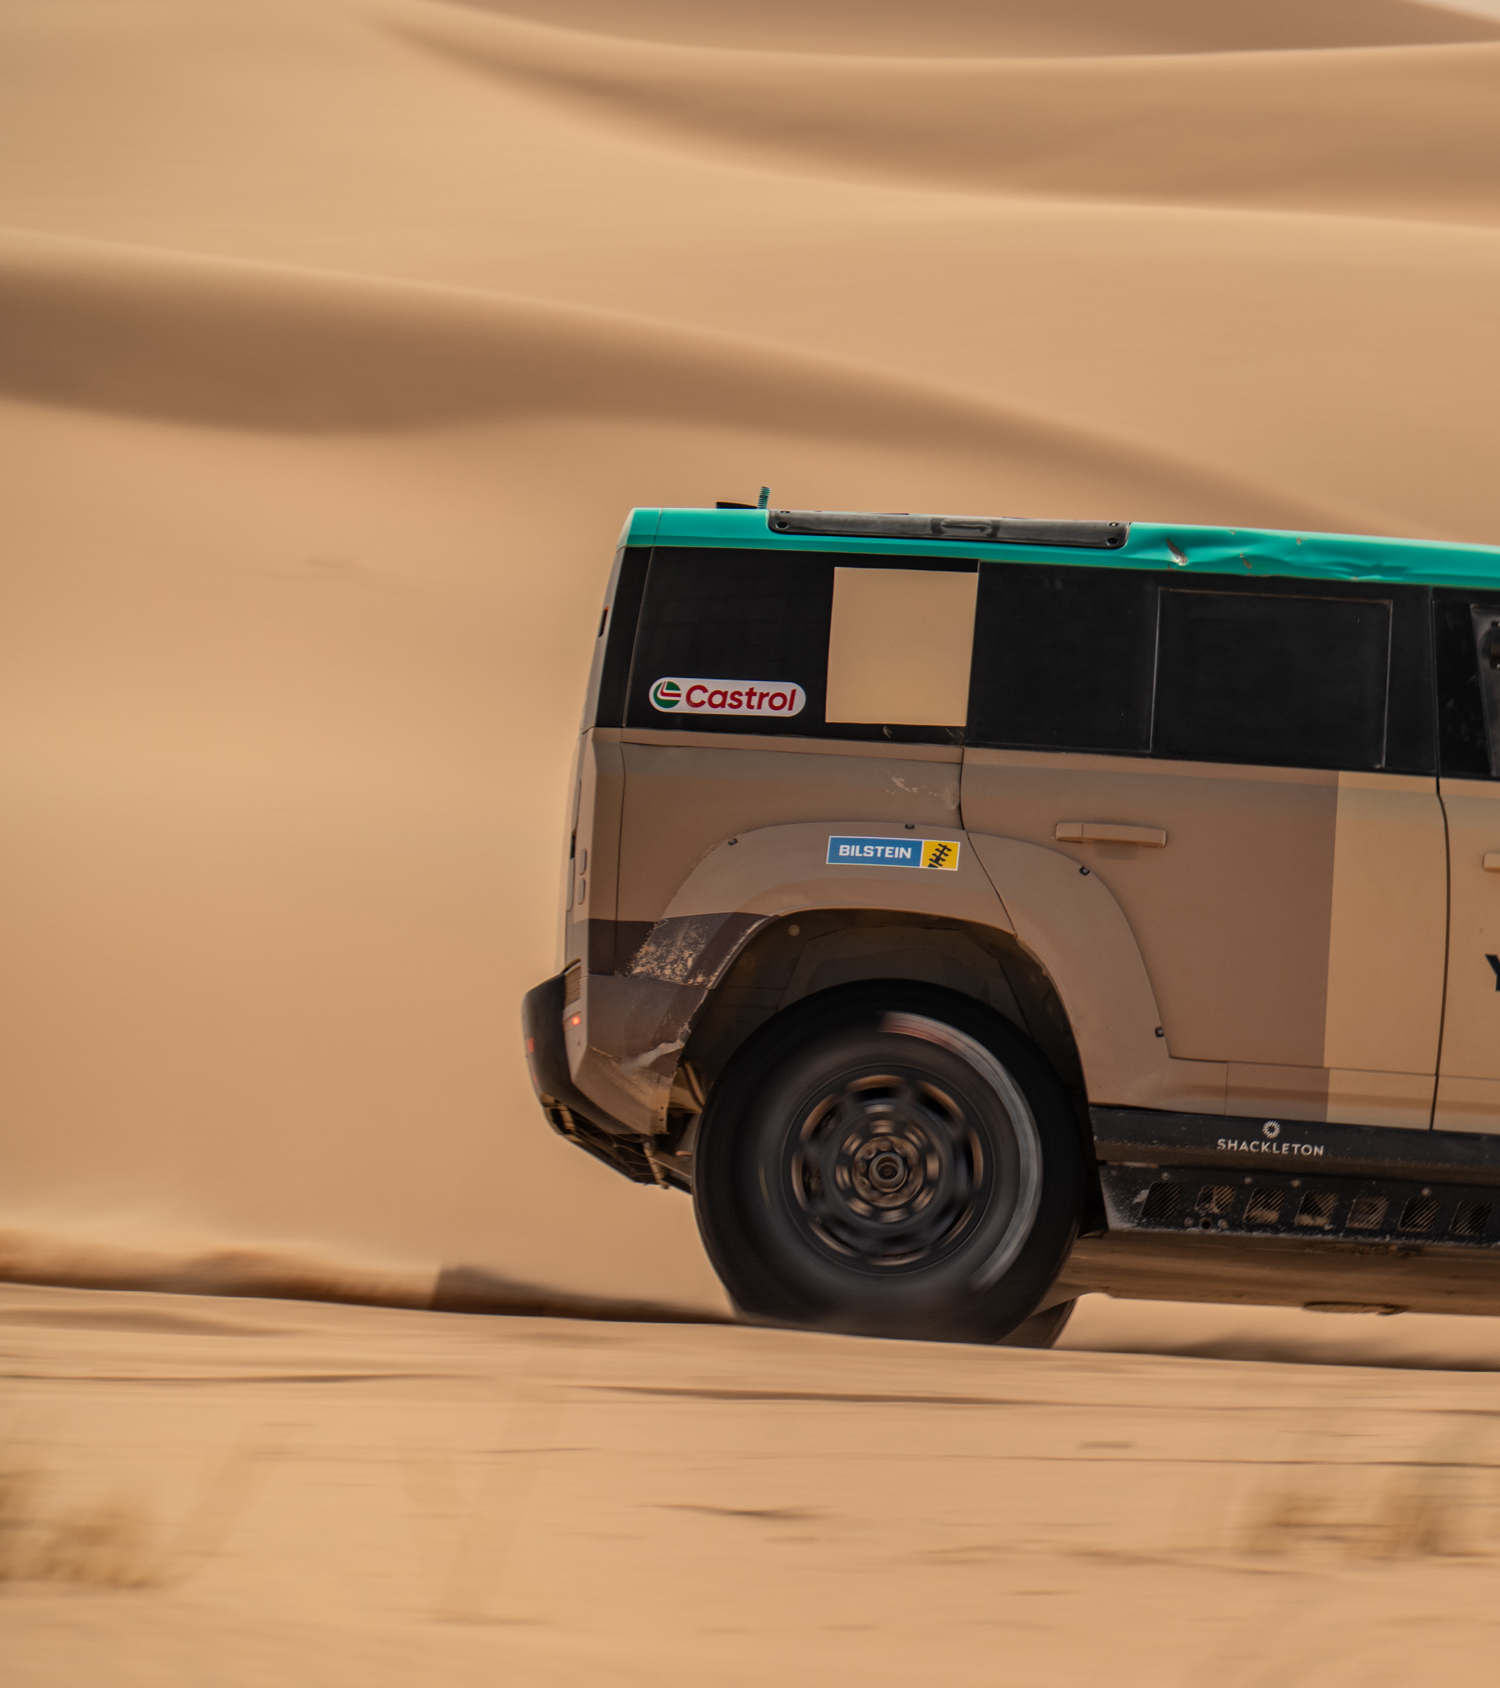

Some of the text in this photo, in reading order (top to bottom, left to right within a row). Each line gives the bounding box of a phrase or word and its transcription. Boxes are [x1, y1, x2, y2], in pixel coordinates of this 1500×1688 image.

[686, 684, 797, 711] Castrol
[838, 844, 912, 860] BILSTEIN
[1217, 1138, 1324, 1157] SHACKLETON
